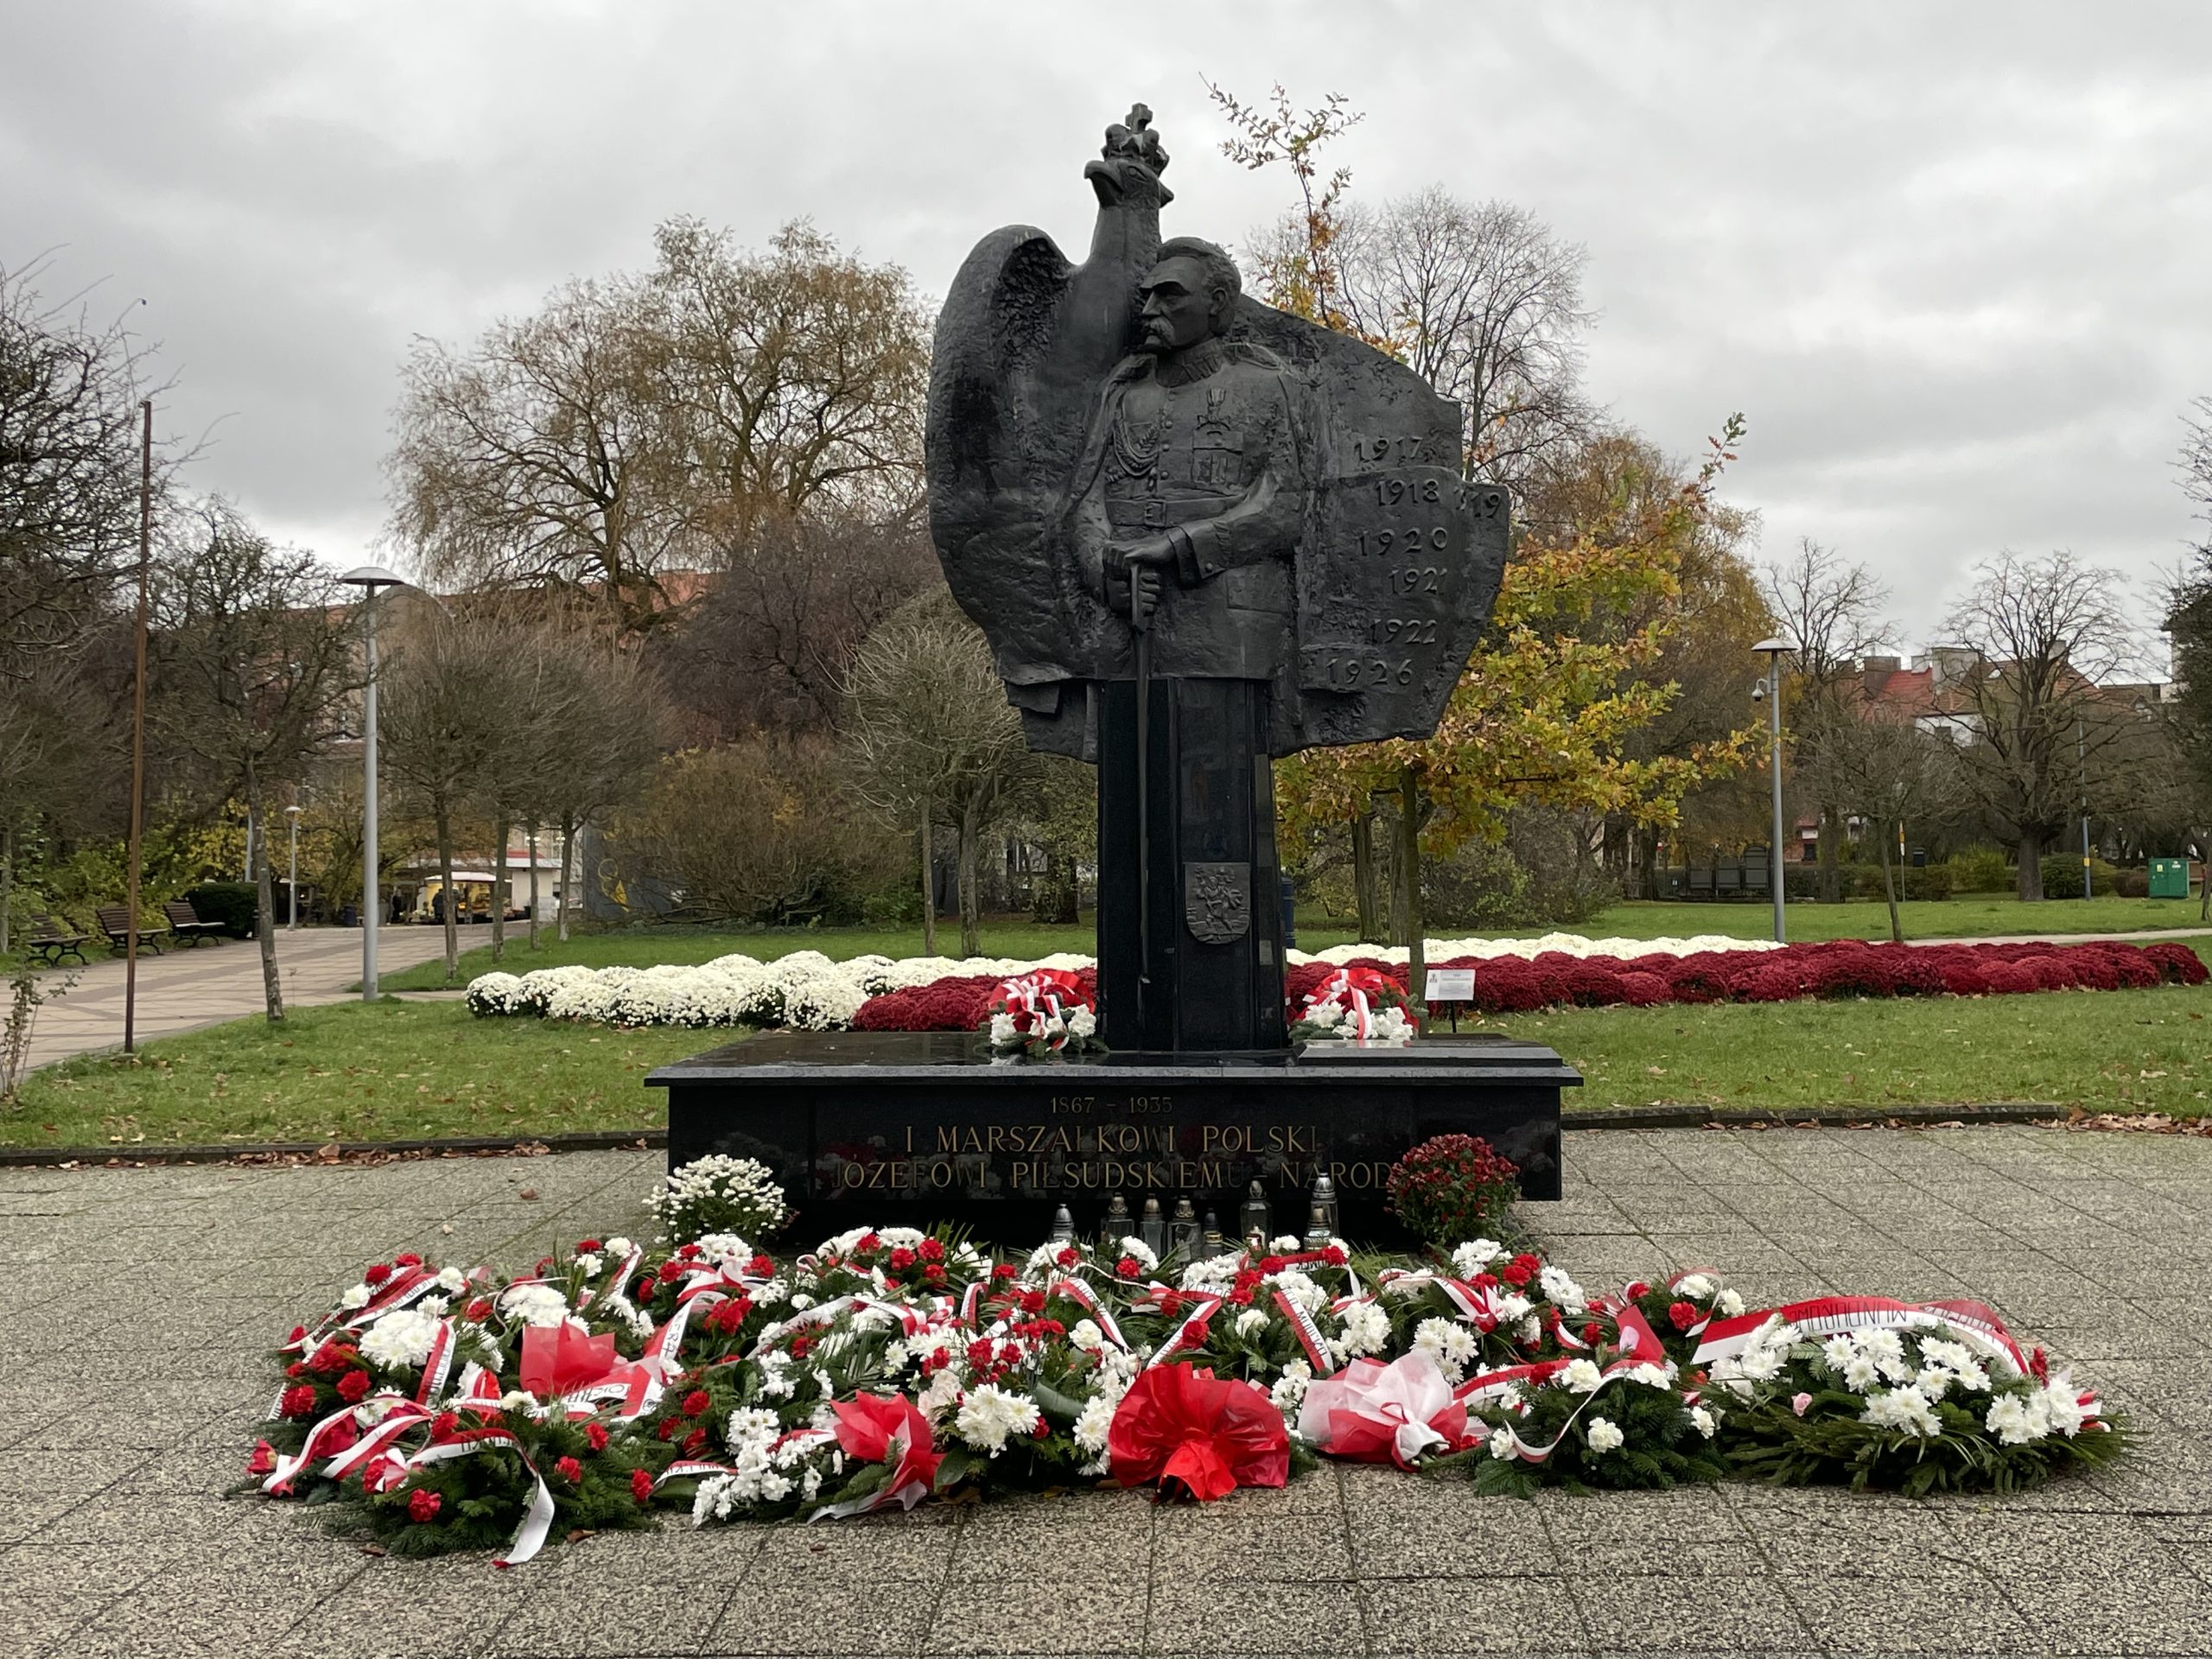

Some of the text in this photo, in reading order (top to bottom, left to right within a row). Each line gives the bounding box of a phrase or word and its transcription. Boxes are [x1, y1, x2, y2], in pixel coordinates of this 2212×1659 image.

[1354, 435, 1423, 461] 1917
[1375, 478, 1440, 507] 1918
[1359, 526, 1449, 556] 1920
[1389, 567, 1448, 596] 1921
[1372, 619, 1439, 645] 1922
[1326, 658, 1414, 685] 1926
[1049, 1096, 1096, 1115] 1867
[1128, 1096, 1173, 1115] 1935
[905, 1125, 1319, 1154] I MARSZAŁKOWI POLSKI
[1012, 1160, 1245, 1190] PIŁSUDSKIEMU
